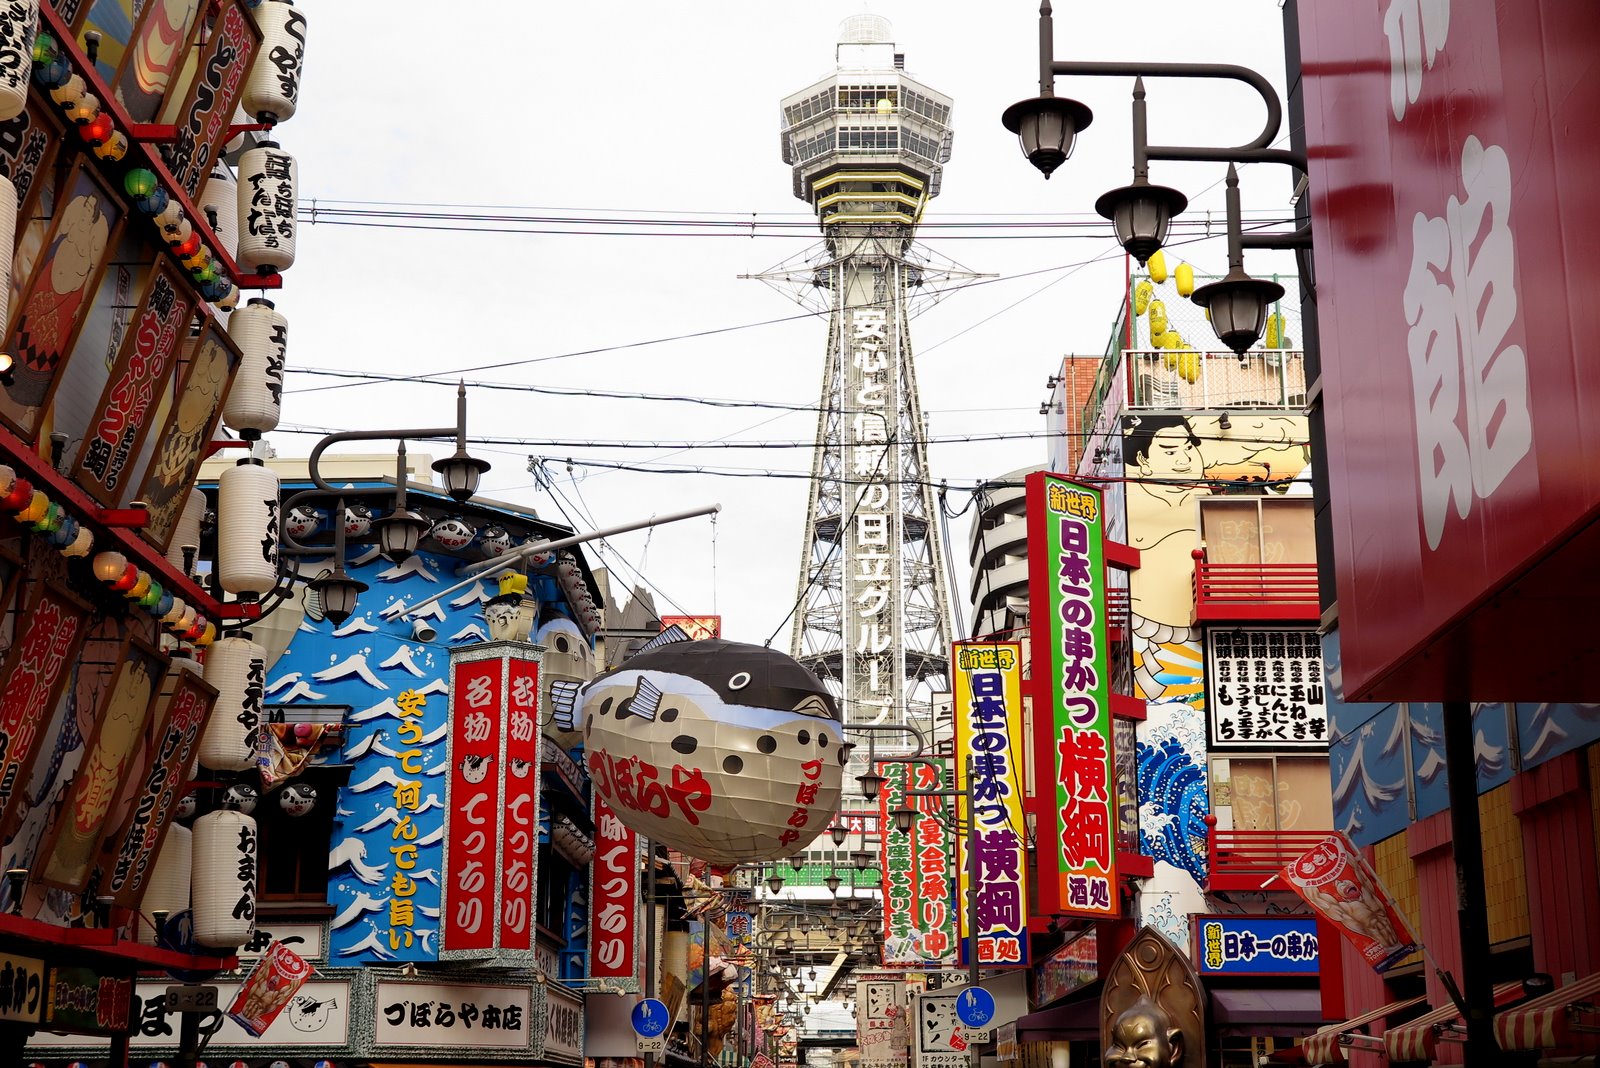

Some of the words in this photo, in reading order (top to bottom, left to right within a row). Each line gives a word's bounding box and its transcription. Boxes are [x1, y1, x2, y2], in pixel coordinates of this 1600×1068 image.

[853, 308, 892, 725] 安心と信頼の日立グループ
[1049, 485, 1097, 521] 新世界
[1059, 520, 1097, 725] 日本一の串かつ
[959, 649, 1014, 670] 新世界
[464, 675, 492, 743] 名物
[510, 675, 535, 743] 名物
[1218, 684, 1235, 739] もち
[1236, 684, 1254, 739] うずら玉子
[1253, 684, 1272, 739] 紅しょうが
[1271, 684, 1289, 739] にんにく
[1289, 684, 1307, 739] 玉ねぎ
[1307, 684, 1326, 739] 山芋
[971, 673, 1010, 826] 日本一の串かつ
[110, 687, 196, 892] 揚げたこ焼き
[389, 688, 426, 951] 安うて何んでも旨い
[588, 748, 712, 826] づぼらや
[779, 758, 824, 846] づぼらや
[1059, 728, 1110, 872] 横綱
[456, 792, 489, 934] てっちり
[504, 792, 531, 934] てっちり
[597, 797, 631, 969] 味てっちり
[965, 830, 1020, 934] 横綱
[1069, 876, 1110, 908] 酒処
[1207, 925, 1222, 967] 新世界
[383, 1002, 522, 1031] づぼらや本店
[638, 1041, 661, 1051] 9-22
[964, 1032, 988, 1041] 9-22
